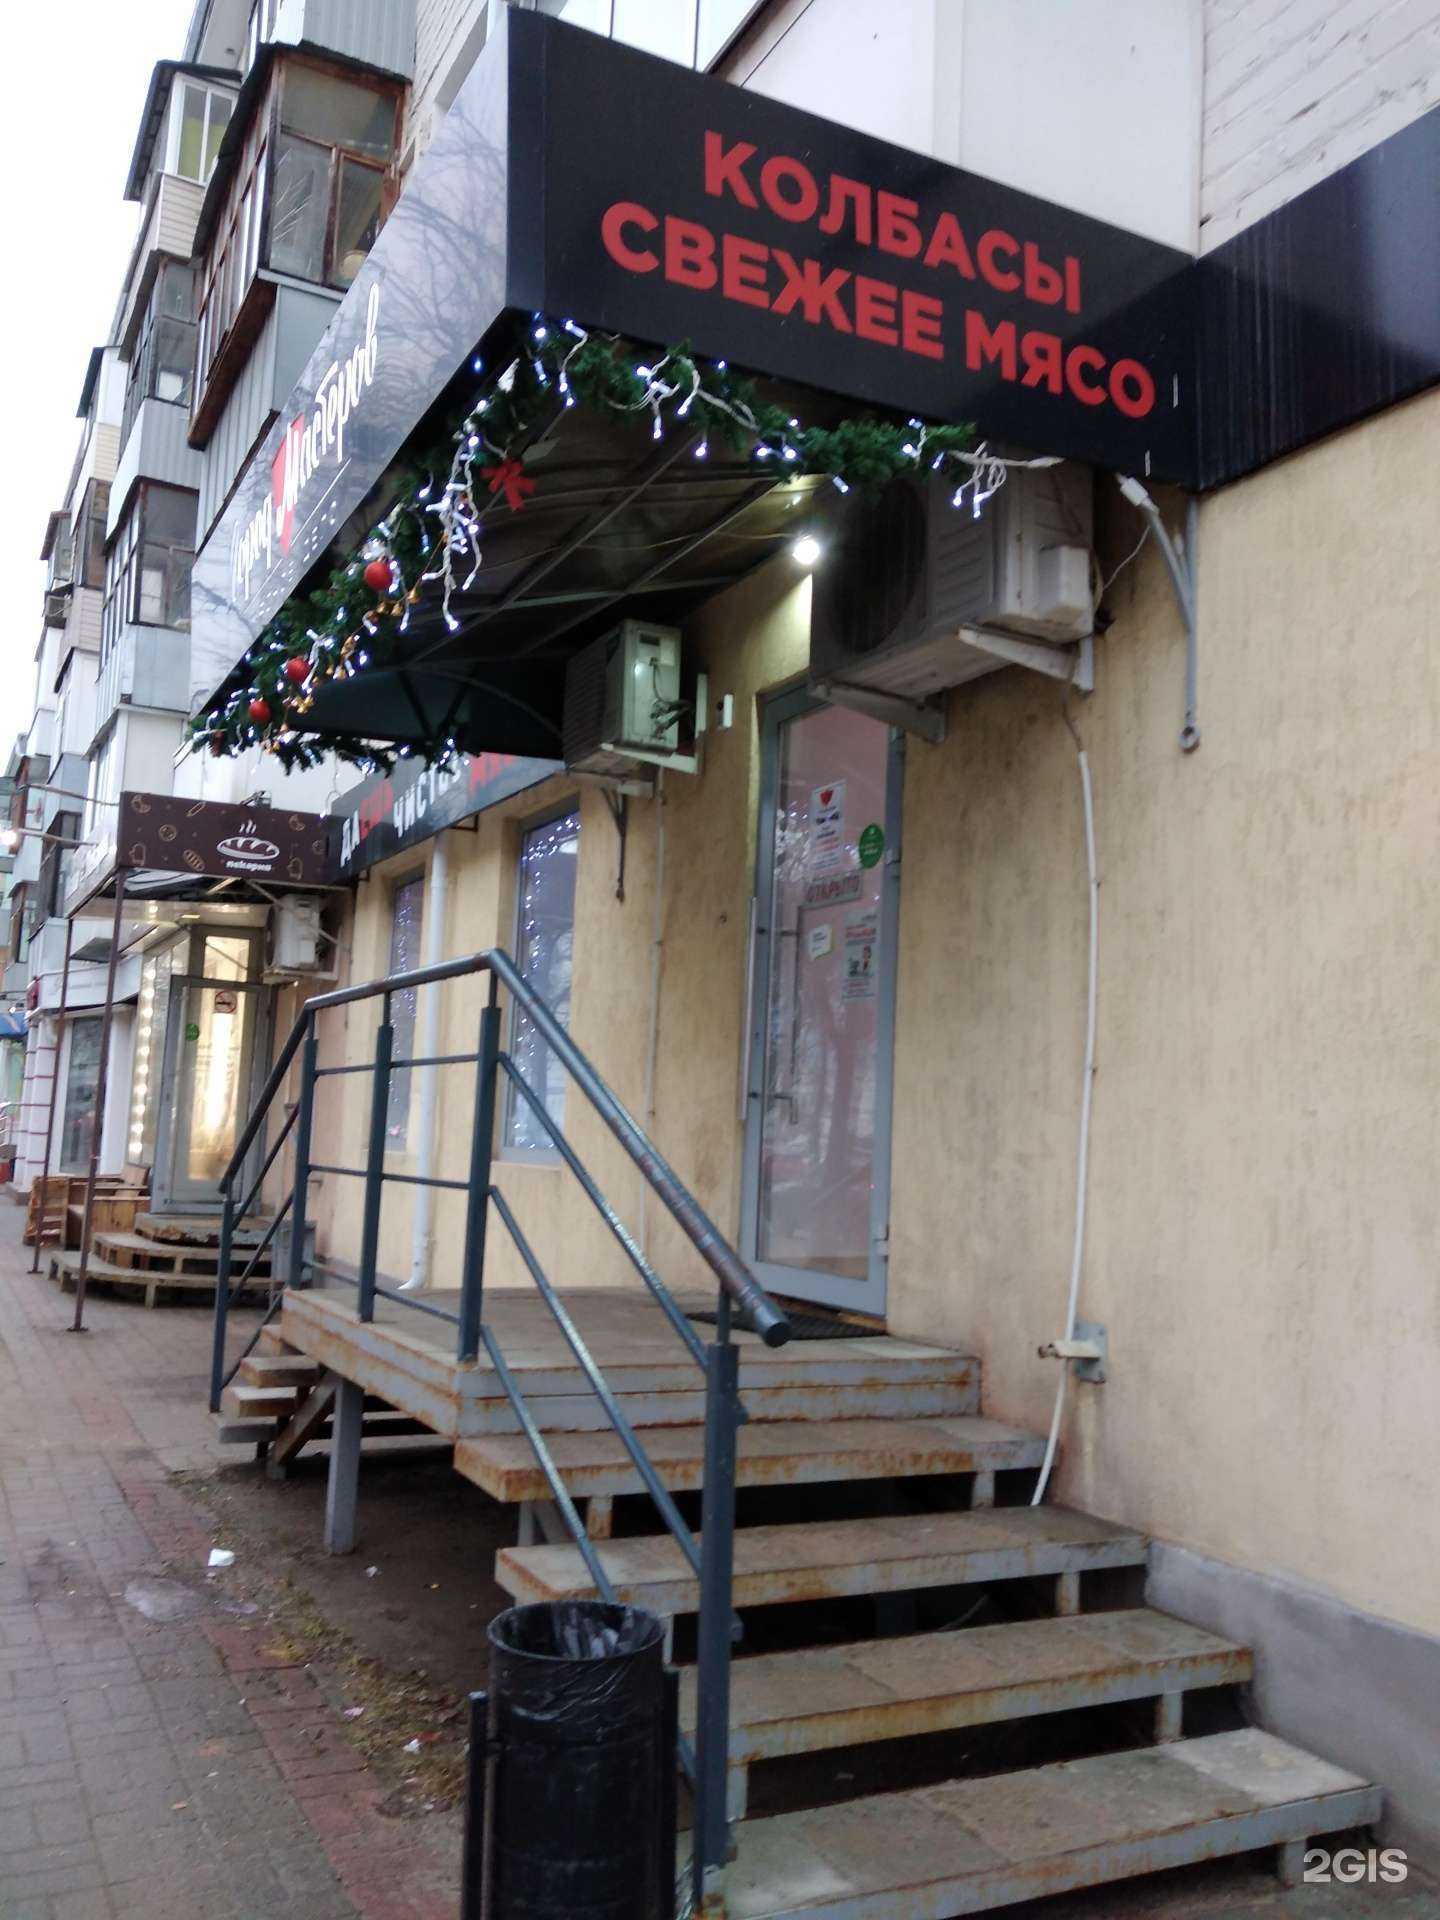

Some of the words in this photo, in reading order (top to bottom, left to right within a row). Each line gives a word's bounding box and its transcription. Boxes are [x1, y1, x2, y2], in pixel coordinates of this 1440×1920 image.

[600, 201, 944, 361] СВЕЖЕЕ
[965, 310, 1156, 419] МЯСО
[704, 130, 1082, 314] КОЛБАСЫ
[275, 281, 379, 537] Мастеров
